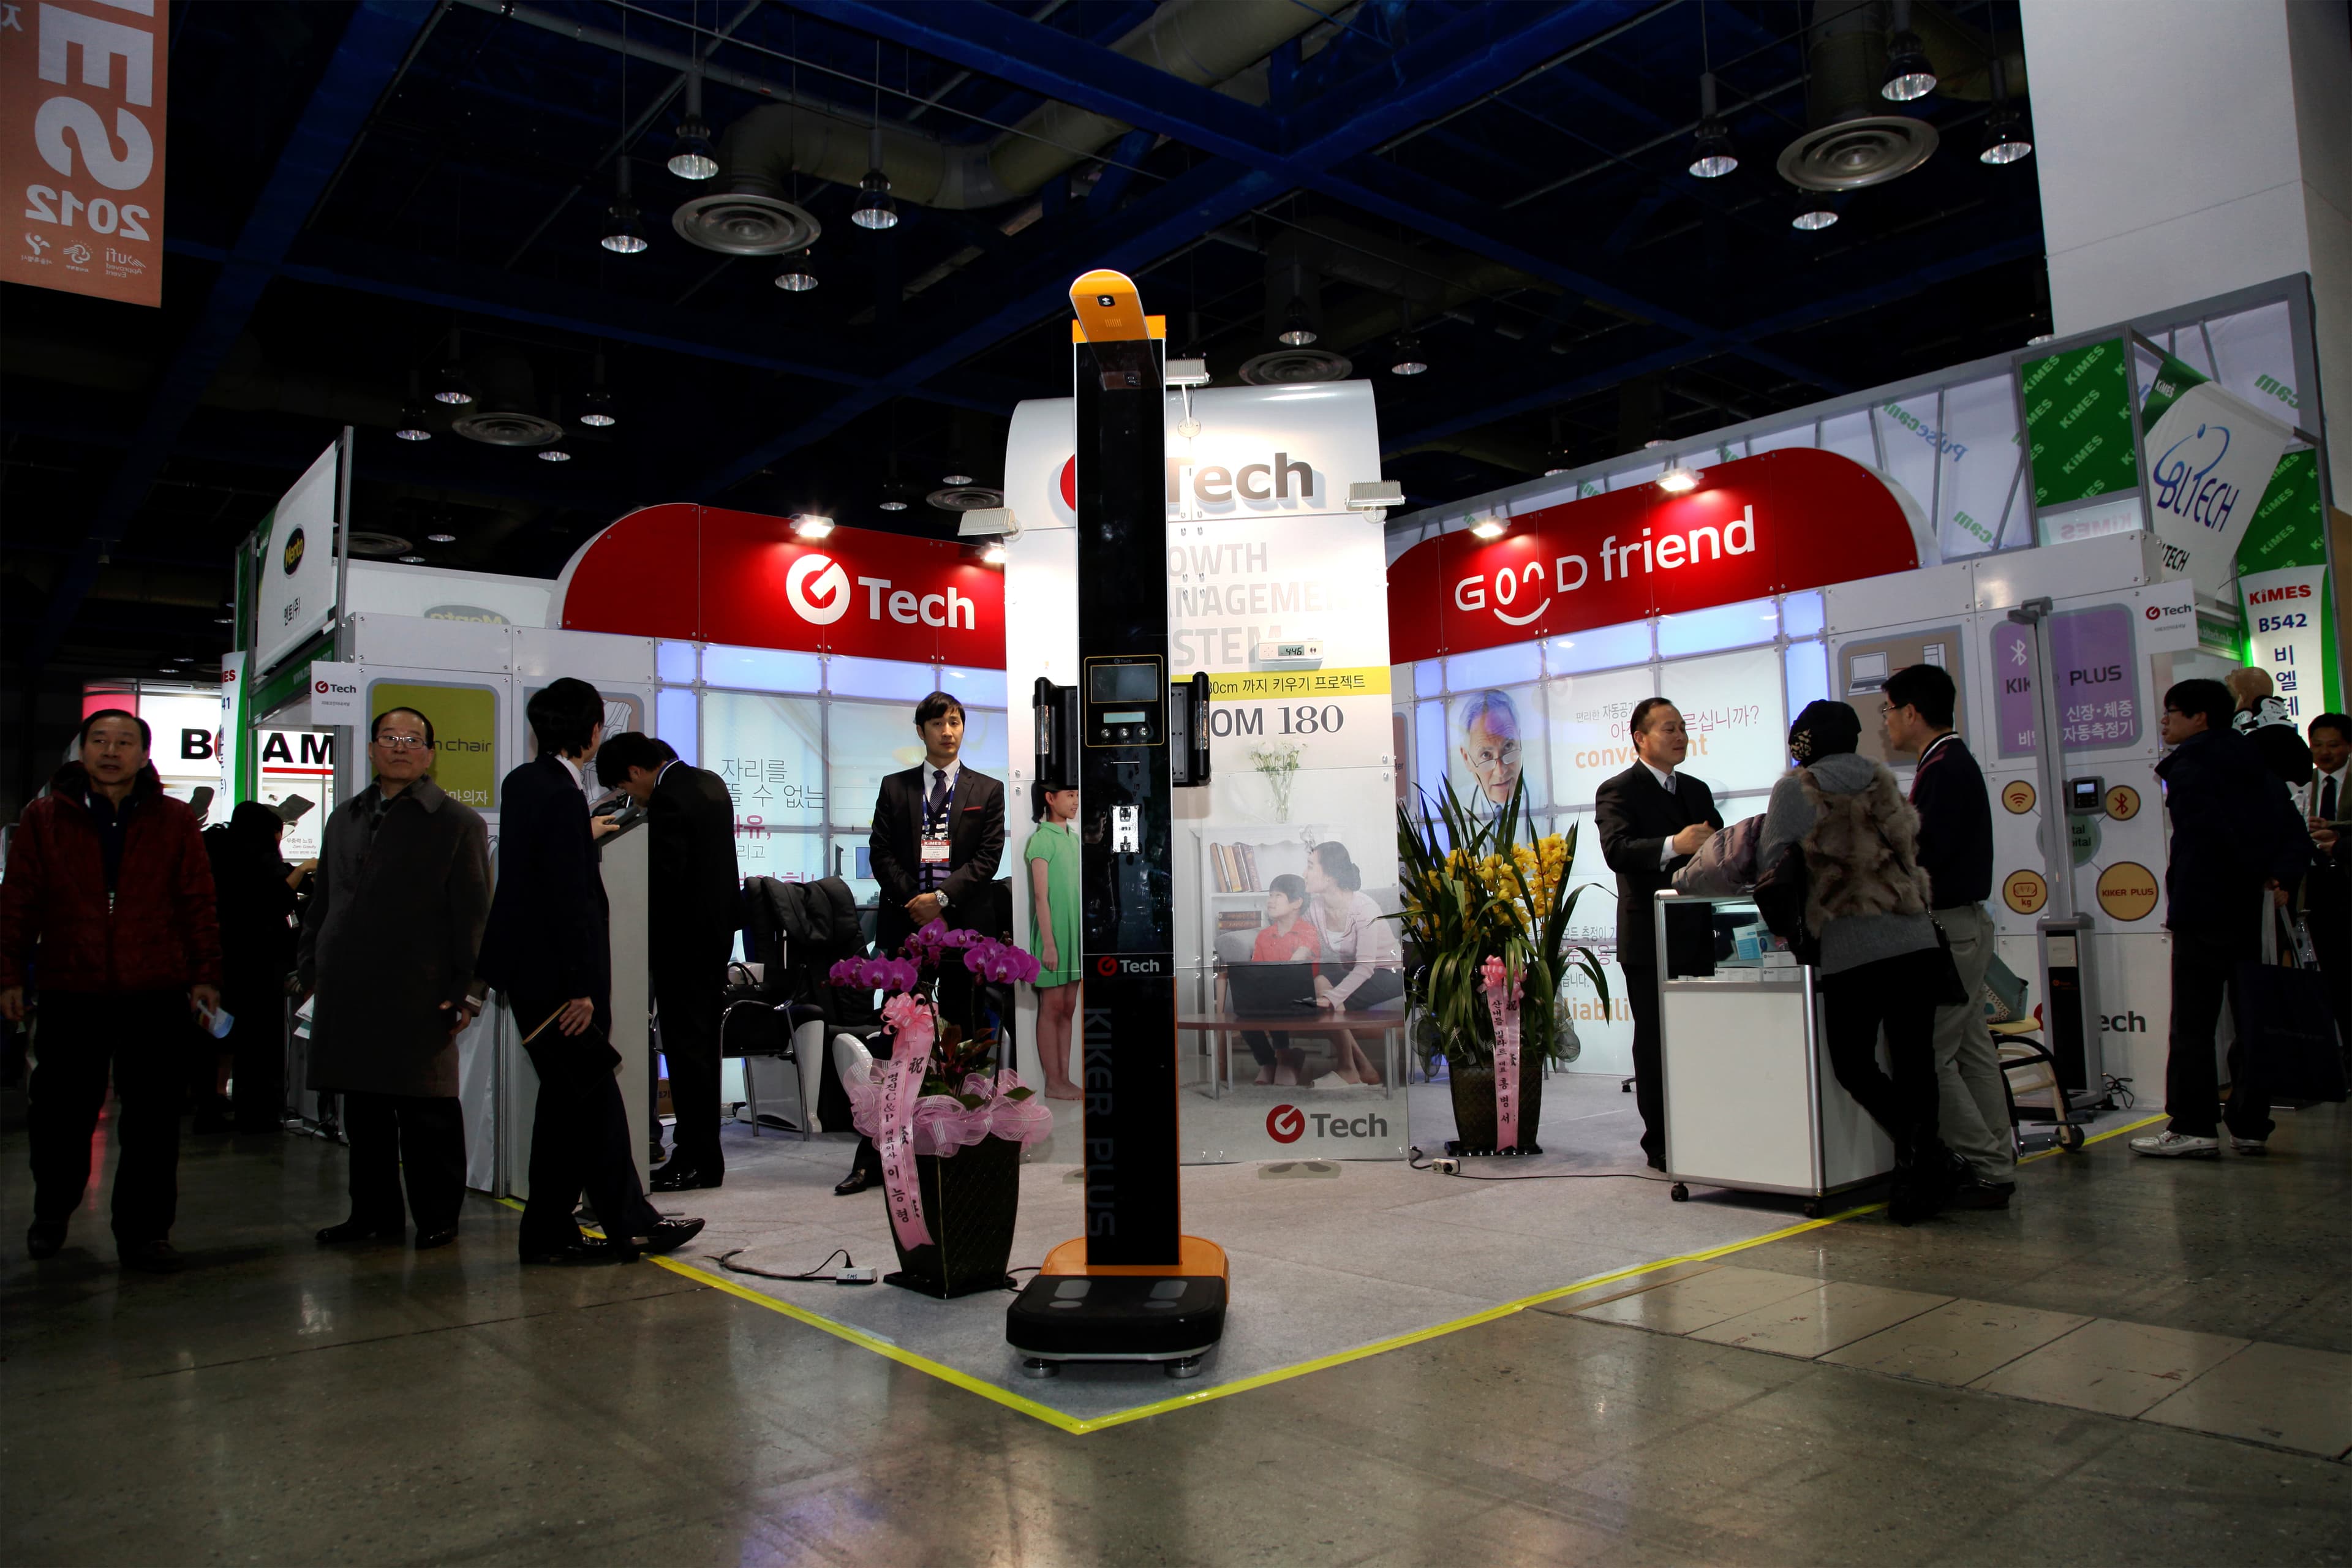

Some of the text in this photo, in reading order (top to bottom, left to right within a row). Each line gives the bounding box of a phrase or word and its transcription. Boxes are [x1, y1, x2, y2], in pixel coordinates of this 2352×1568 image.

[1167, 452, 1314, 504] Tech
[1599, 505, 1756, 582] friend
[858, 576, 975, 630] Tech
[2249, 584, 2312, 606] KiMES
[2162, 604, 2192, 616] Tech
[2259, 613, 2308, 633] B542
[1242, 677, 1268, 693] 까지
[1273, 676, 1310, 692] 키우기
[1314, 674, 1366, 690] 프로젝트
[2069, 665, 2122, 687] PLUS
[330, 684, 356, 693] Tech
[1277, 704, 1344, 735] 180
[2062, 718, 2134, 743] 자동측정기
[446, 737, 491, 752] chair
[722, 758, 788, 783] 자리를
[446, 789, 488, 806] 마의자
[752, 784, 774, 807] 수
[783, 785, 826, 809] 없는
[2021, 898, 2032, 908] kg
[2101, 887, 2154, 897] KIKER PLUS
[1582, 925, 1607, 942] 측정이
[1120, 959, 1160, 973] Tech
[1310, 1112, 1387, 1137] Tech
[885, 1129, 897, 1159] 대표이사
[1087, 1137, 1116, 1238] PLUS
